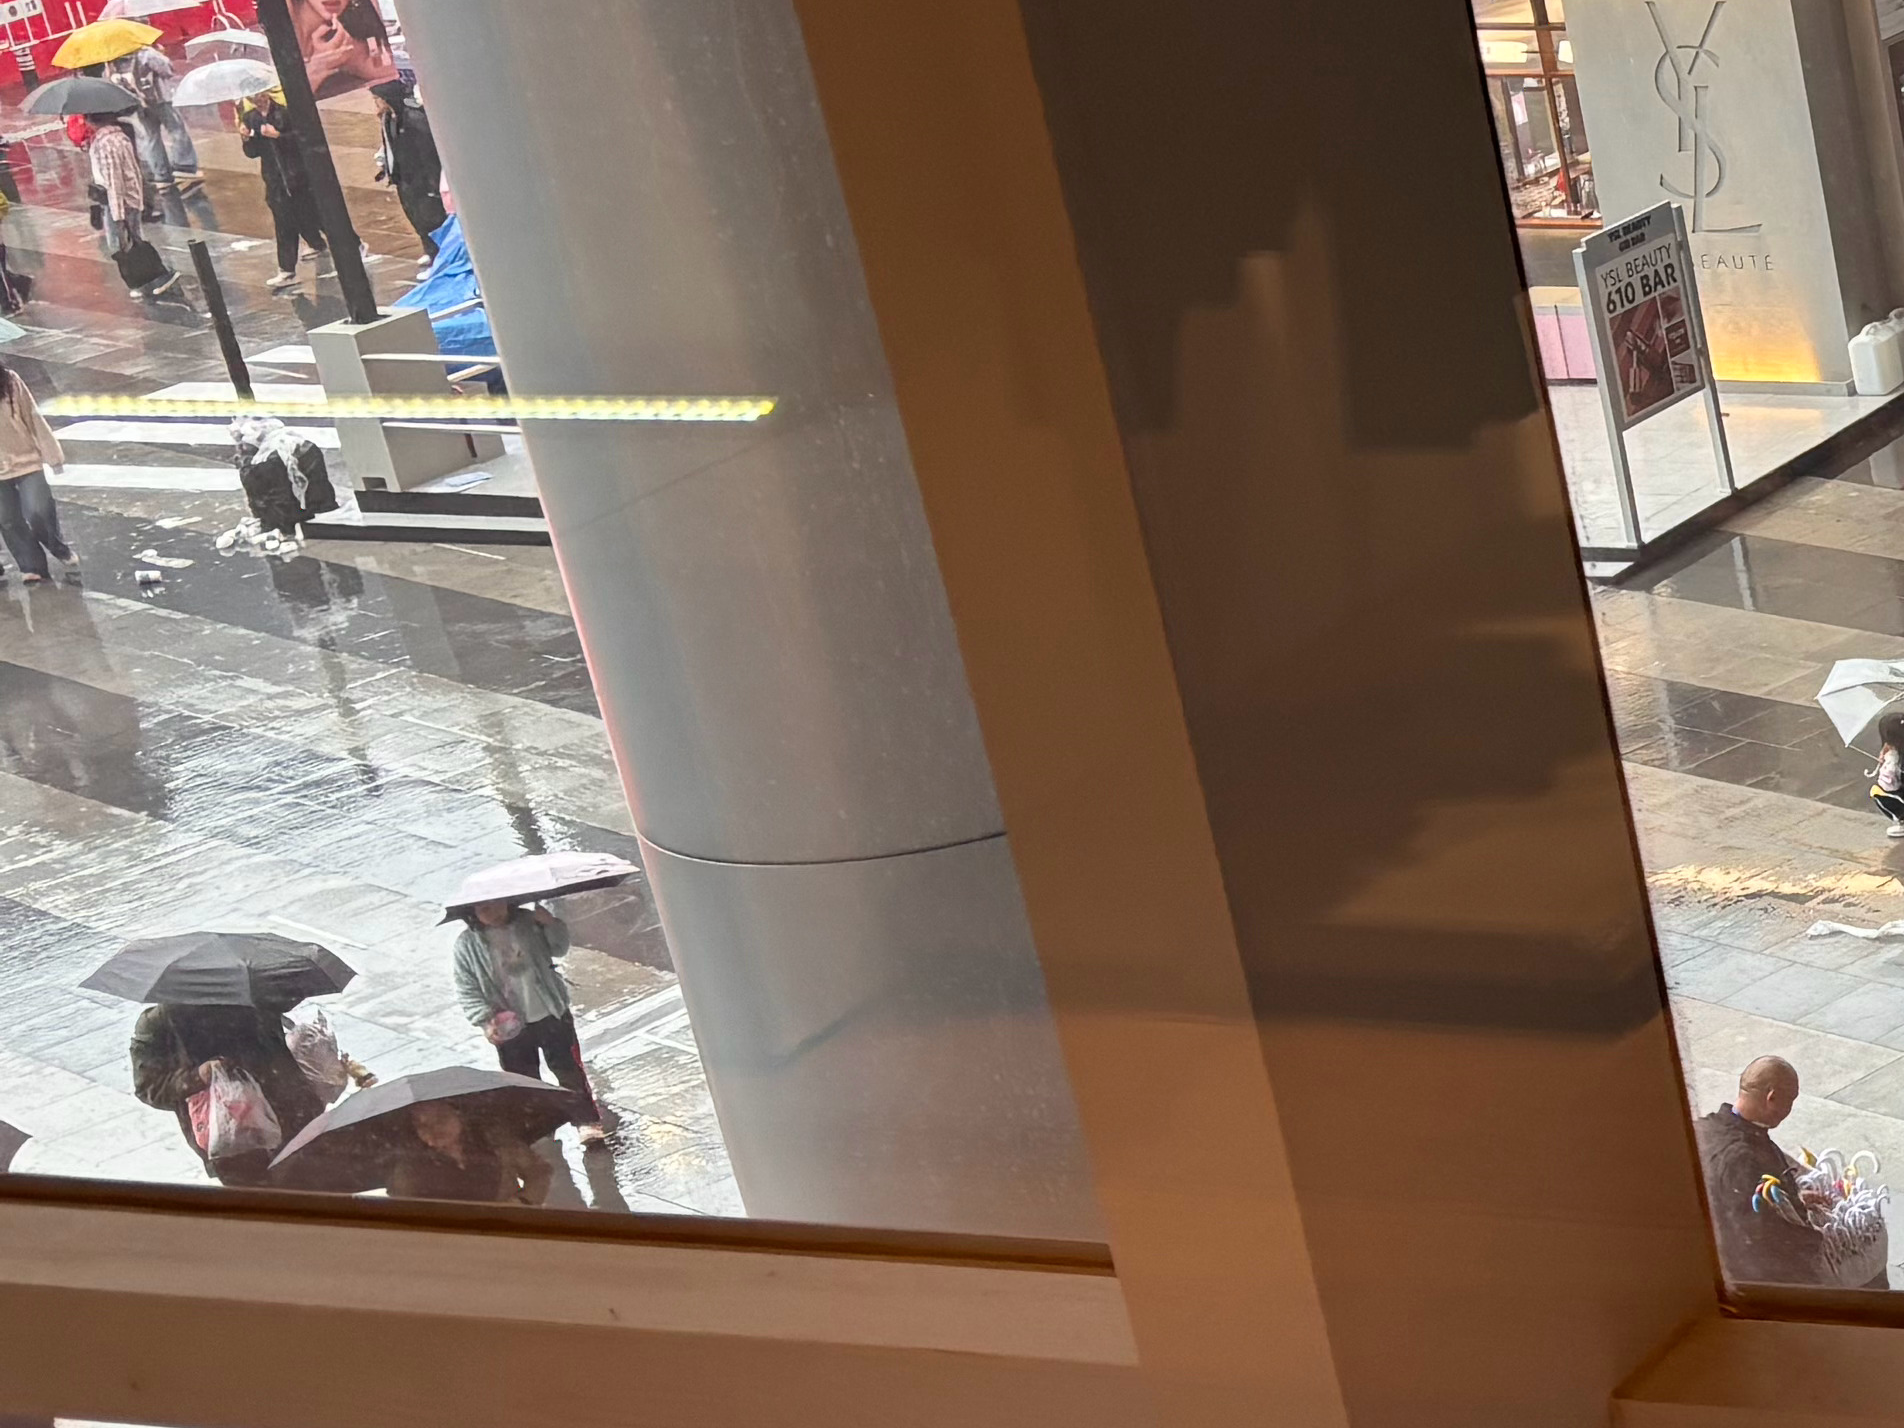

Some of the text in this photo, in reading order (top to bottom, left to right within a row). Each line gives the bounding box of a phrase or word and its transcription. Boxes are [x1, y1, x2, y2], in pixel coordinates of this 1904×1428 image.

[1601, 243, 1673, 289] YSL BEAUTY
[1693, 252, 1776, 273] EAUTE
[1605, 262, 1678, 315] 610 BAR
